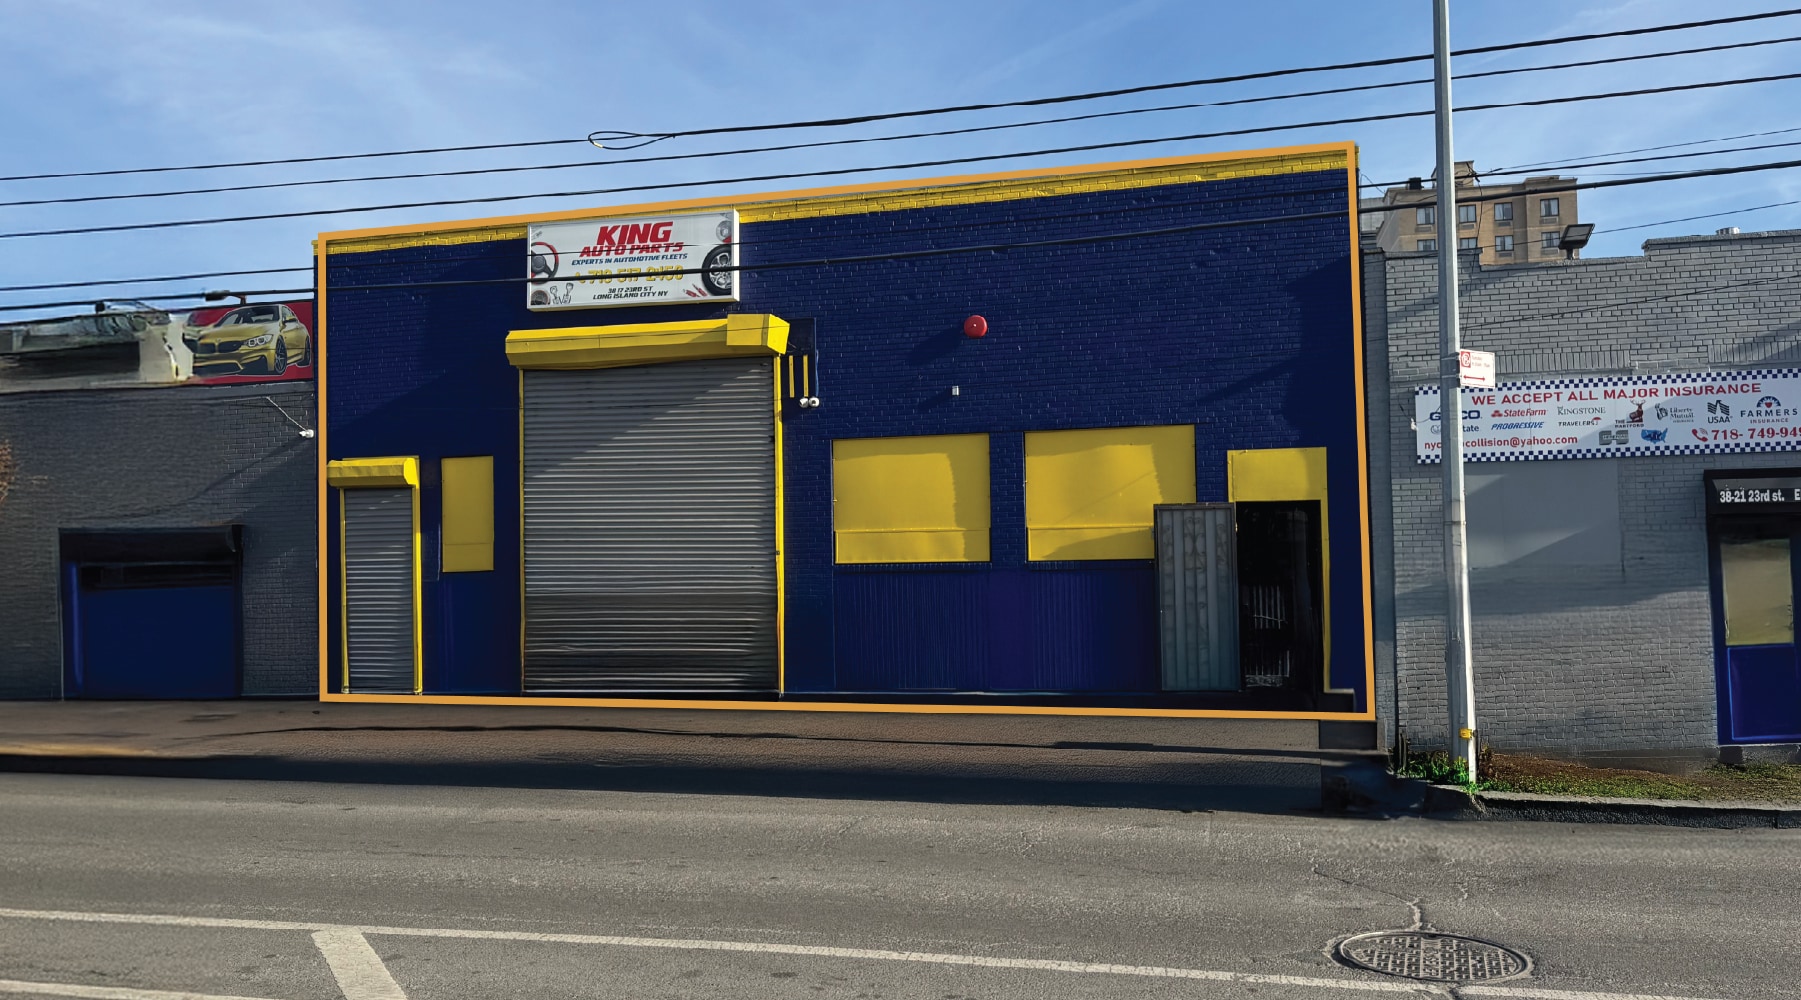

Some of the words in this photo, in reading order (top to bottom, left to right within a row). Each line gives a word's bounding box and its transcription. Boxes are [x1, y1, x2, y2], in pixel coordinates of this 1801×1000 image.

[596, 221, 673, 245] KING
[579, 244, 627, 257] AUTO
[629, 242, 684, 254] PARTS
[571, 257, 603, 266] EXPERTS
[613, 254, 660, 263] AUTOMOTIVE
[661, 252, 688, 260] FLEETS
[1471, 395, 1496, 406] WE
[1501, 392, 1563, 404] ACCEPT
[1567, 390, 1599, 401] ALL
[1603, 387, 1659, 400] MAJOR
[1664, 383, 1762, 396] INSURANCE
[1557, 406, 1606, 415] KINGSTONE
[1740, 408, 1798, 417] FARMERS
[1707, 415, 1731, 424] USAA
[1491, 421, 1545, 431] PROGRESSIVE
[1711, 429, 1743, 440] 718-
[1719, 490, 1746, 503] 38-21
[1748, 489, 1770, 502] 23rd
[1772, 489, 1785, 501] st.
